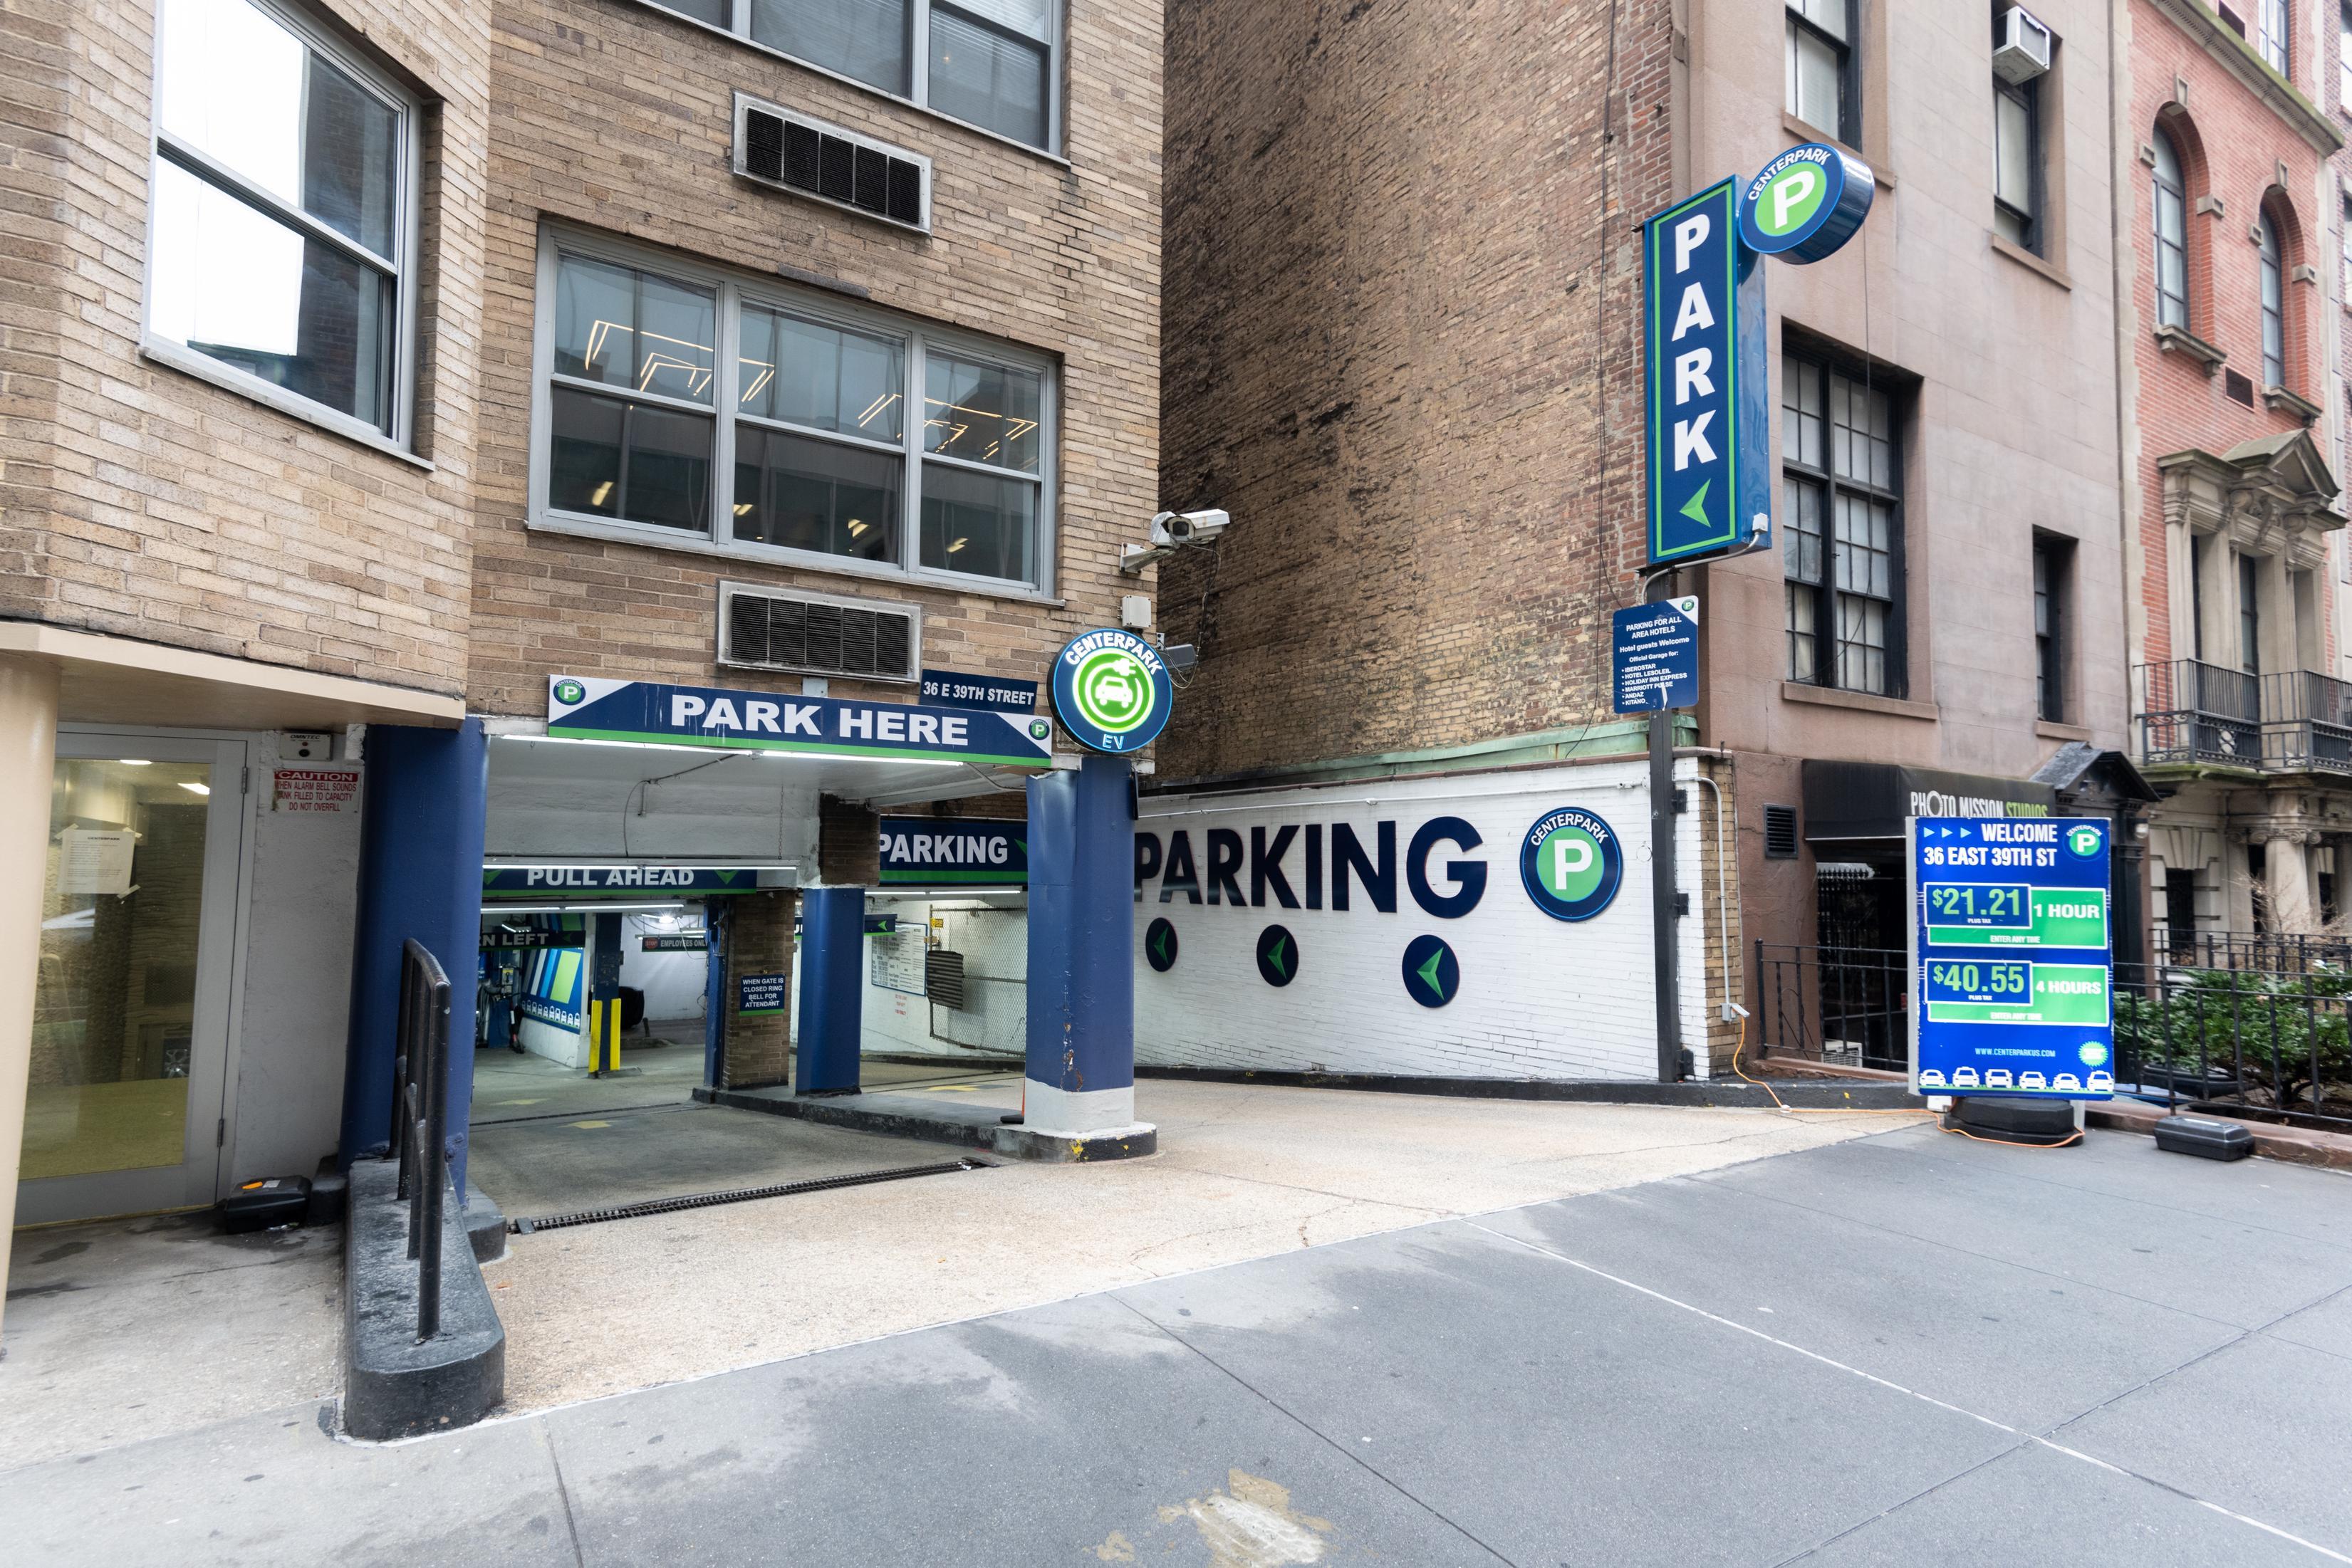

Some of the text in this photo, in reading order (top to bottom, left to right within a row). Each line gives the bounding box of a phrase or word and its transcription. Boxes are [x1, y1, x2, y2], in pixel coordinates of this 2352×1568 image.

[1748, 147, 1831, 200] CENTERPARK
[1773, 170, 1815, 229] P
[1671, 214, 1717, 472] PARK
[1625, 616, 1682, 632] PARKING FOR ALL
[1631, 626, 1675, 639] AREA HOTELS
[1619, 637, 1690, 653] Hotel guests Welcome
[1066, 632, 1162, 675] CENTERPARK
[1628, 654, 1648, 663] Official
[1648, 652, 1668, 661] Garage
[1625, 663, 1656, 673] IBEROSTAR
[1644, 668, 1671, 676] LESOLEIL
[1625, 677, 1649, 686] HOLIDAY
[1660, 672, 1687, 681] EXPRESS
[564, 686, 578, 699] P
[923, 681, 1034, 706] 36 E 39TH STREET
[1625, 684, 1654, 693] MARRIOTT
[1625, 691, 1644, 700] ANDAZ
[1625, 698, 1645, 706] KITANO
[671, 694, 969, 746] PARK HERE
[1035, 724, 1045, 736] P
[1102, 733, 1124, 750] EV
[279, 771, 353, 781] CAUTION
[275, 780, 357, 792] WHEN ALARM BELL SOUNDS
[294, 792, 313, 800] FILLED
[316, 793, 323, 801] TO
[326, 793, 353, 801] CAPACITY
[1910, 790, 2048, 817] PHOTO MISSION STUDIOS
[288, 802, 340, 812] DO NOT OVERFILL
[1531, 813, 1608, 846] CENTERPARK
[1981, 823, 2058, 843] WELCOME
[2066, 825, 2103, 837] CENTERPARK
[2077, 833, 2096, 852] P
[1554, 839, 1593, 890] P
[1924, 847, 2058, 867] 36 EAST 39TH ST
[1134, 816, 1488, 919] PARKING
[527, 869, 694, 886] PULL AHEAD
[1932, 888, 2020, 916] $21.21
[2033, 904, 2100, 919] 1 HOUR
[502, 934, 549, 946] LEFT
[1933, 964, 2024, 993] $40.55
[2036, 980, 2101, 995] 4 HOURS
[1975, 1047, 2056, 1057] WWW.CENTERPARKUS.COM
